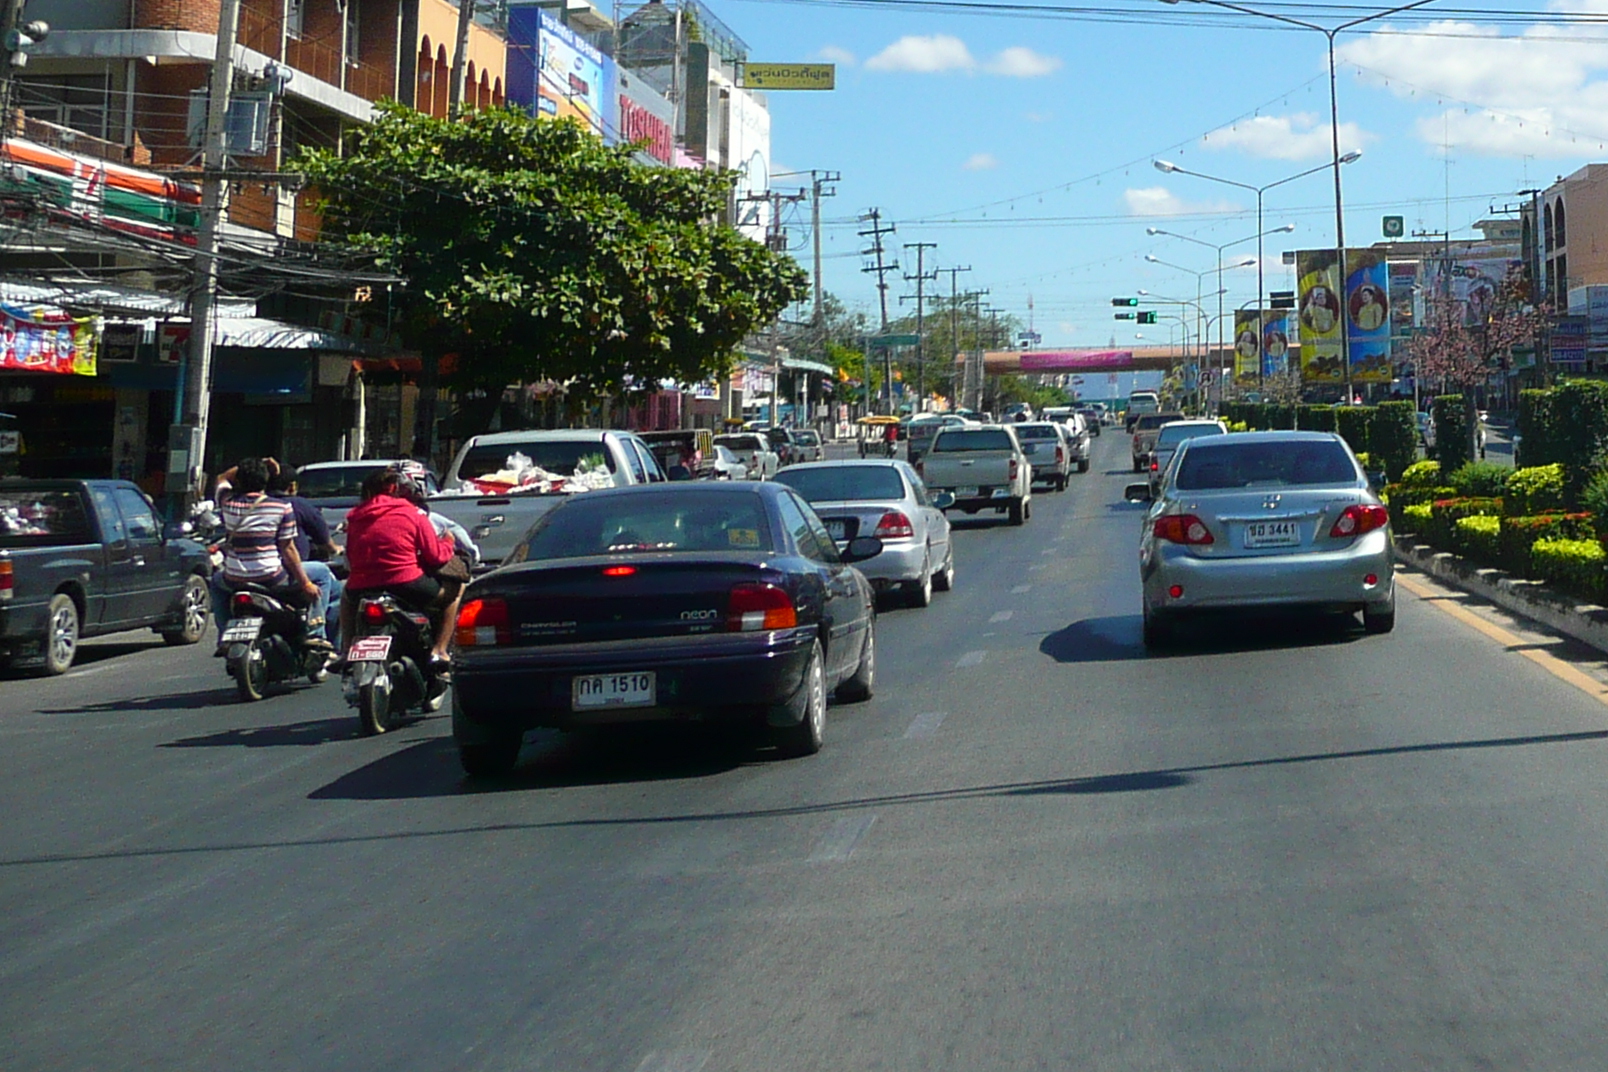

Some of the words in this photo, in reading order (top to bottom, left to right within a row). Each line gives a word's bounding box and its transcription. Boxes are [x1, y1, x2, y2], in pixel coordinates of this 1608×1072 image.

[620, 94, 671, 166] TOSHIBA
[1268, 522, 1295, 536] 3441
[680, 609, 717, 620] neon
[580, 678, 603, 695] กค
[611, 675, 649, 693] 1510
